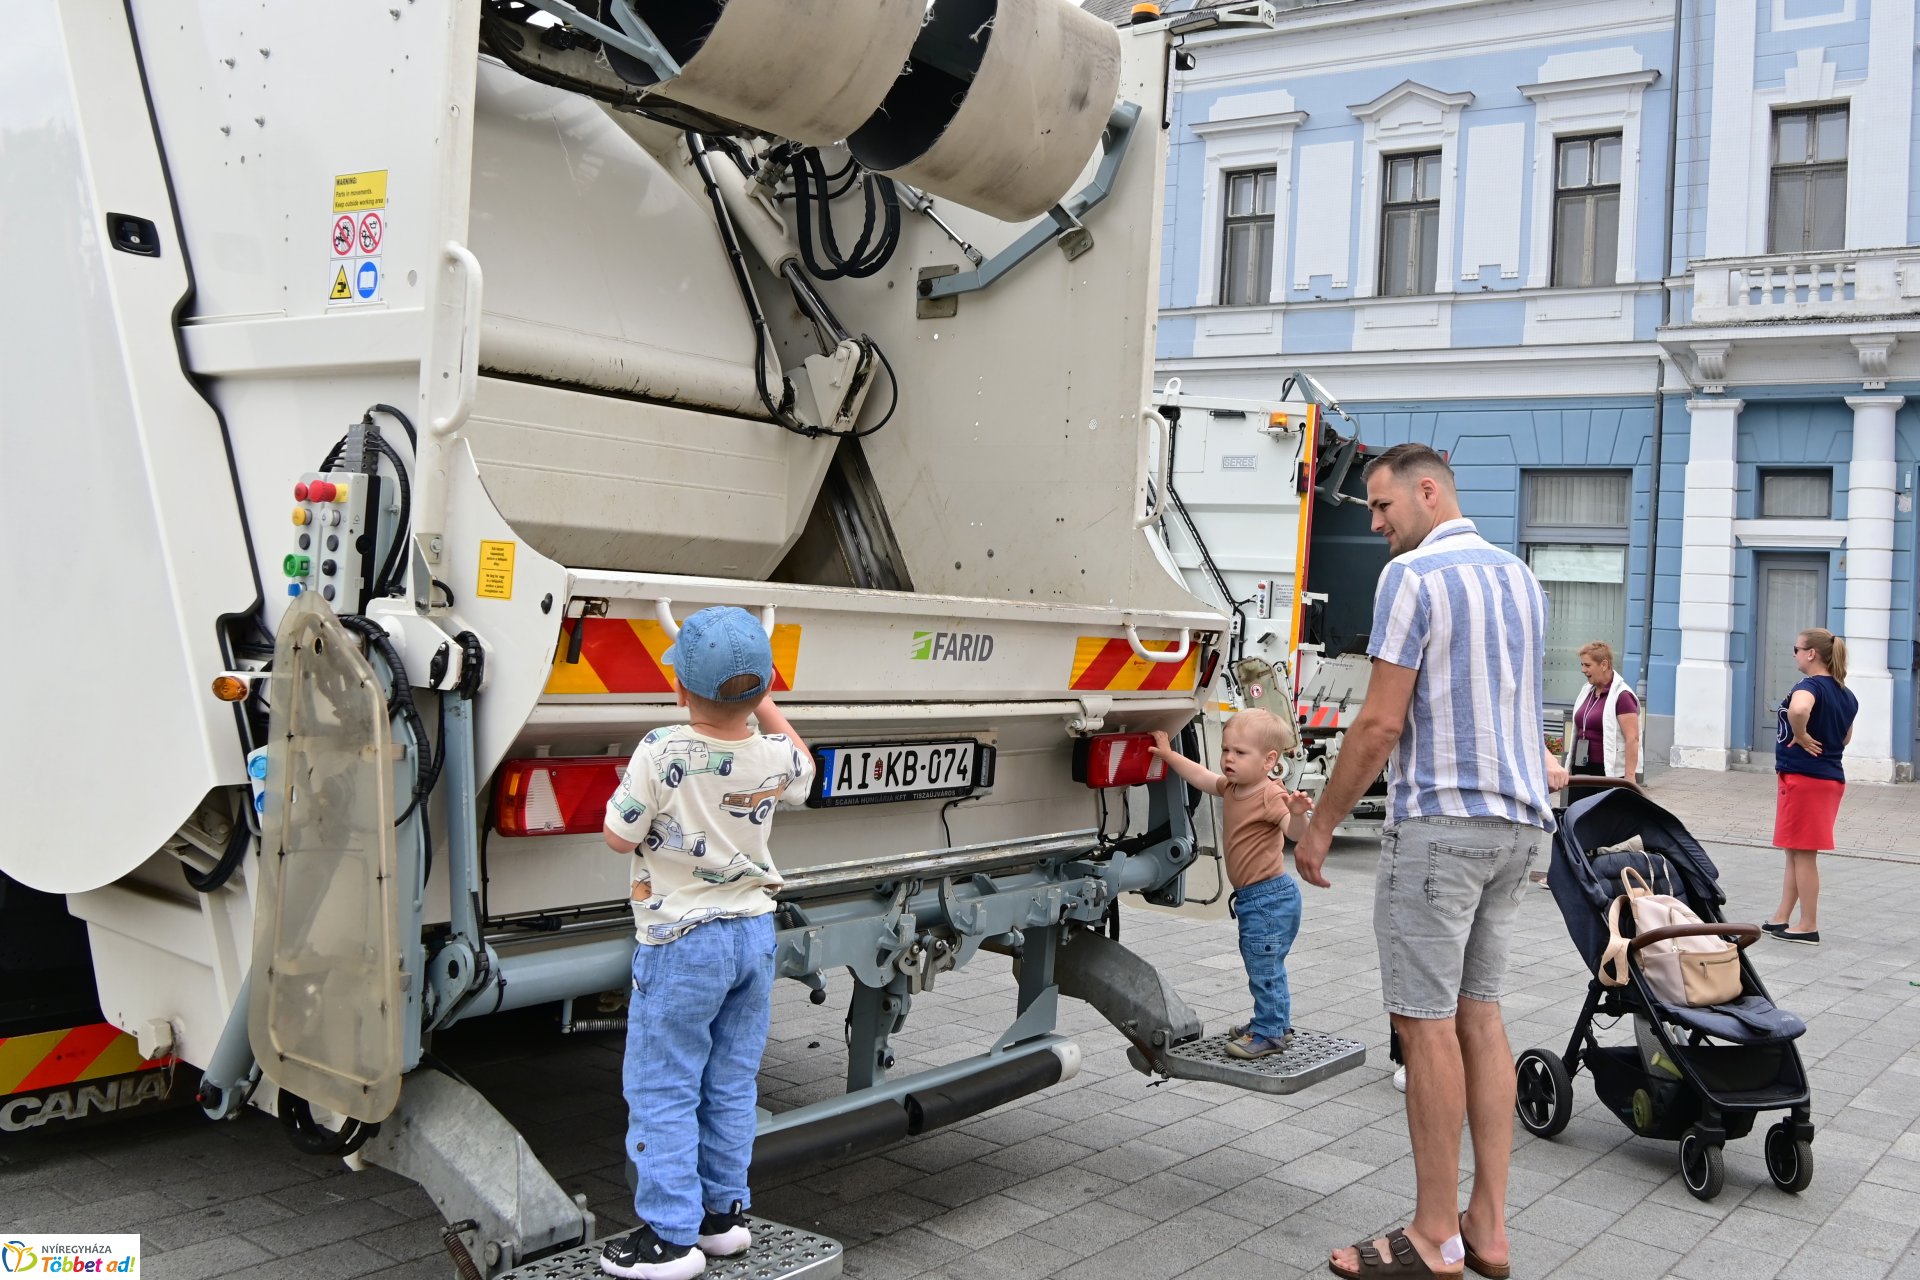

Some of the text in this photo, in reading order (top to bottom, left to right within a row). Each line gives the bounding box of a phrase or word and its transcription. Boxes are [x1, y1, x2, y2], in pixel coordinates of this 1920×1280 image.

[336, 177, 357, 185] WARNING:
[1224, 458, 1254, 467] SERES
[931, 632, 994, 662] FARID
[837, 752, 871, 790] AI
[835, 797, 860, 806] SCANIA
